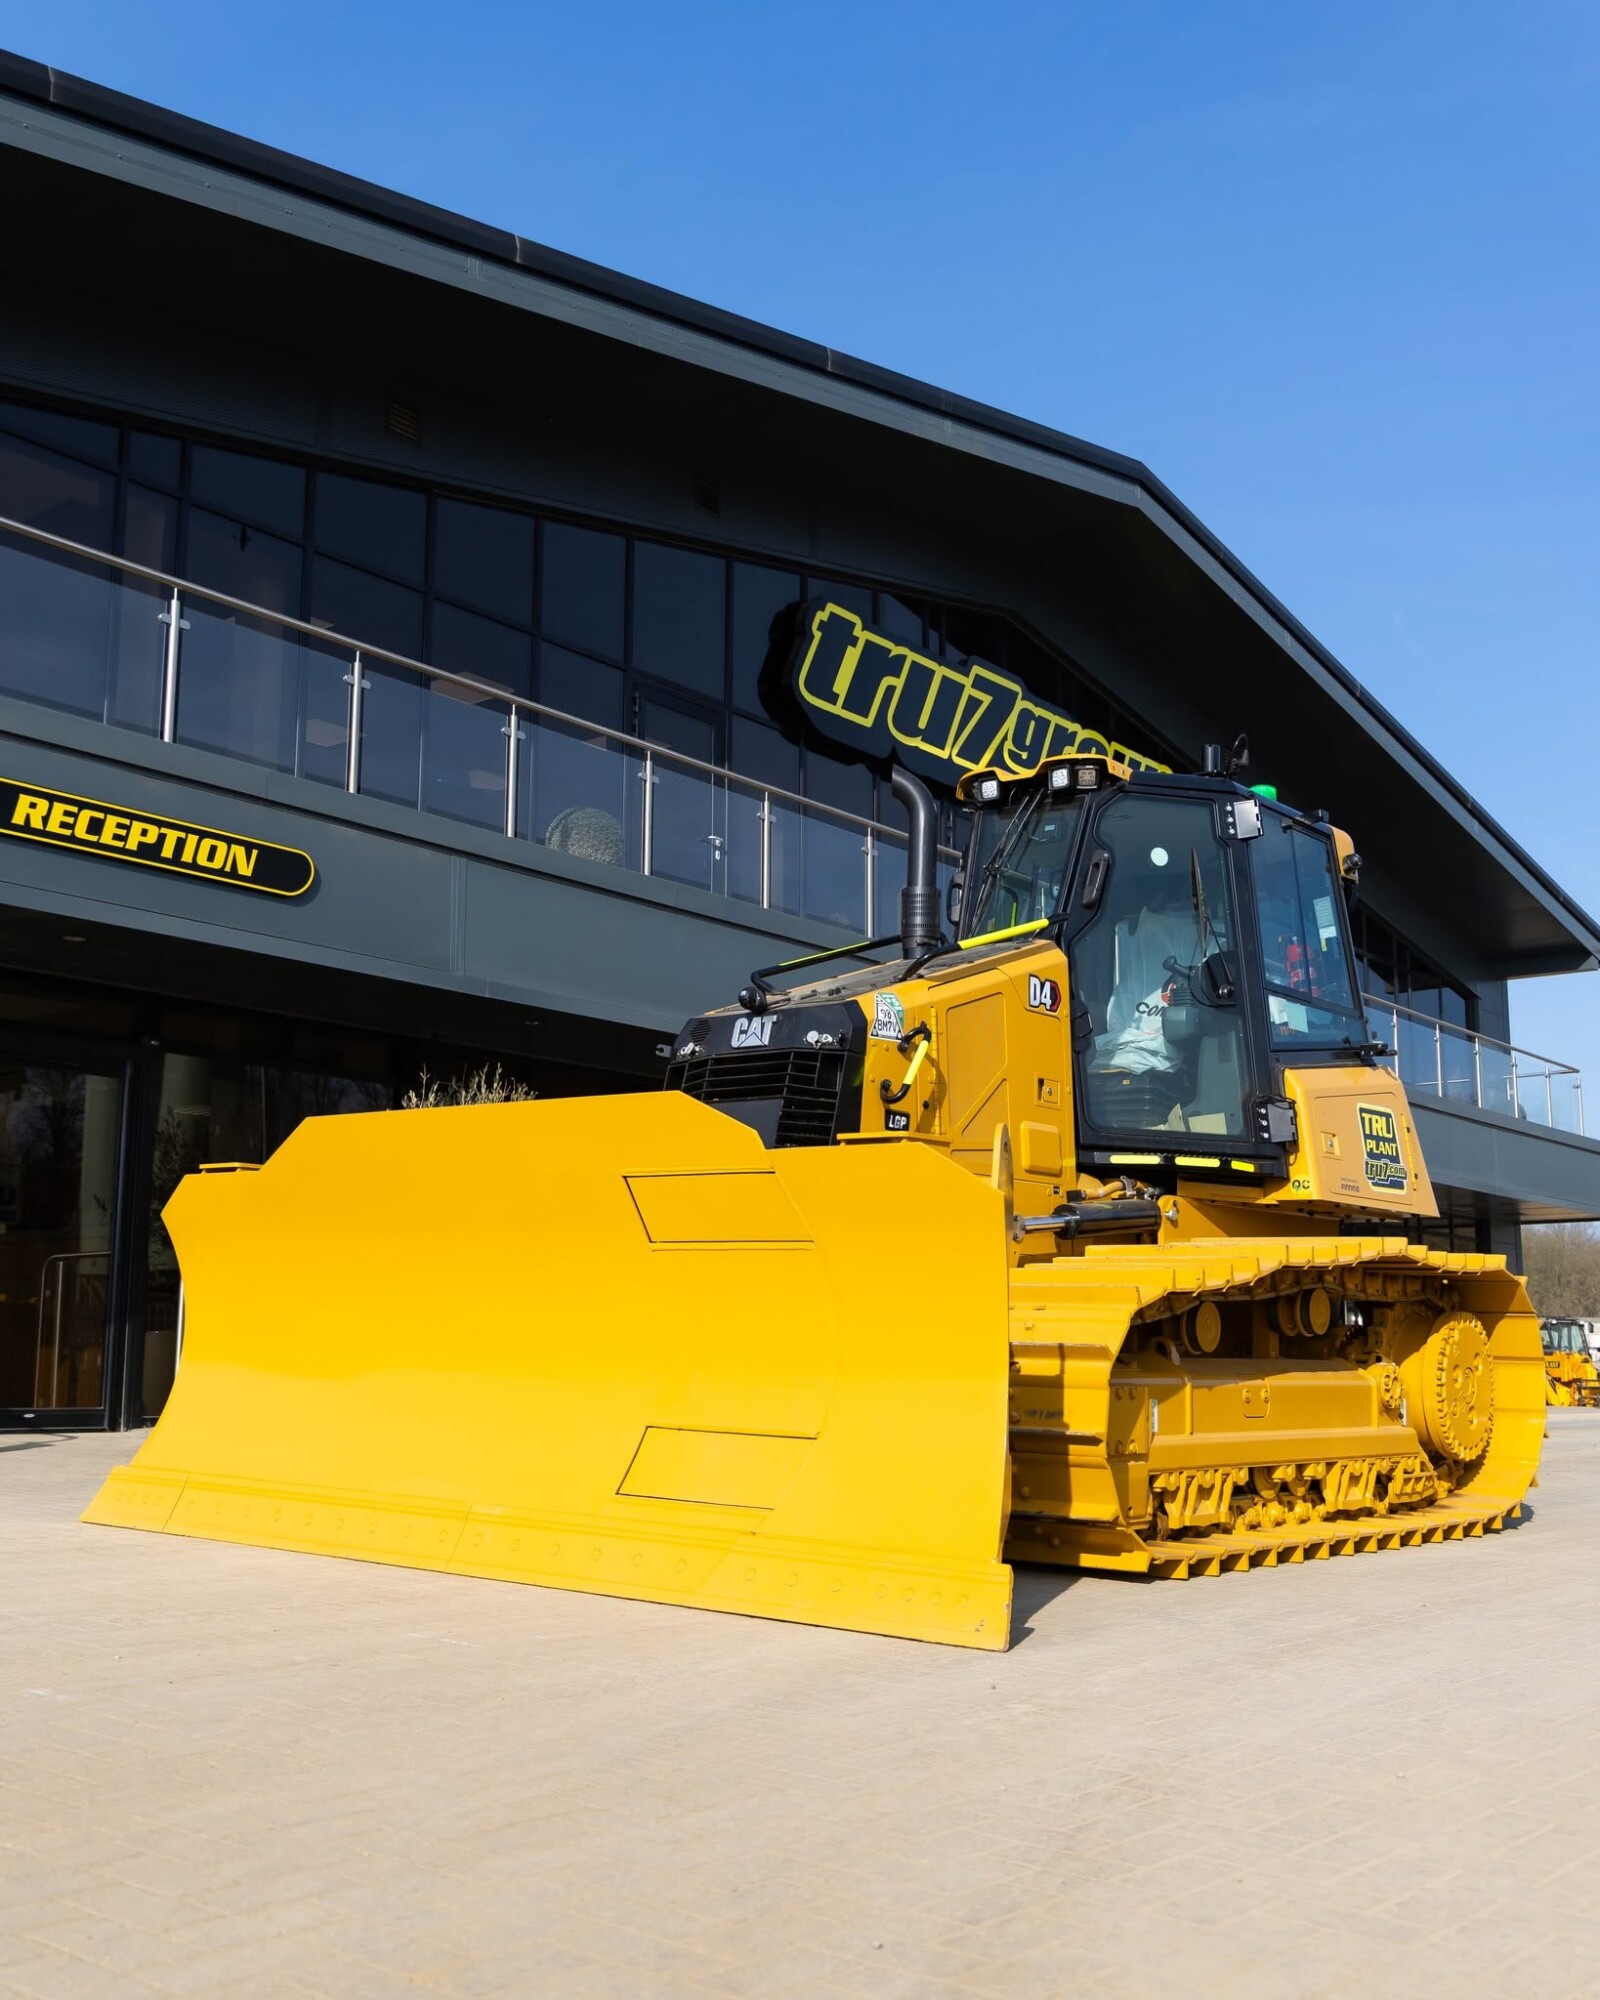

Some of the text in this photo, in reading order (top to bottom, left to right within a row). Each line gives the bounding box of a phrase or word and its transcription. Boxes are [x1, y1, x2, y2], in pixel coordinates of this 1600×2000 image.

[800, 602, 1173, 779] tru7gr
[11, 793, 259, 877] RECEPTION
[1029, 975, 1051, 1011] D4
[731, 1014, 778, 1048] CAT
[888, 1114, 907, 1130] LGP
[1361, 1112, 1393, 1139] TRU
[1365, 1138, 1397, 1157] PLANT
[1364, 1160, 1407, 1180] tru7.com
